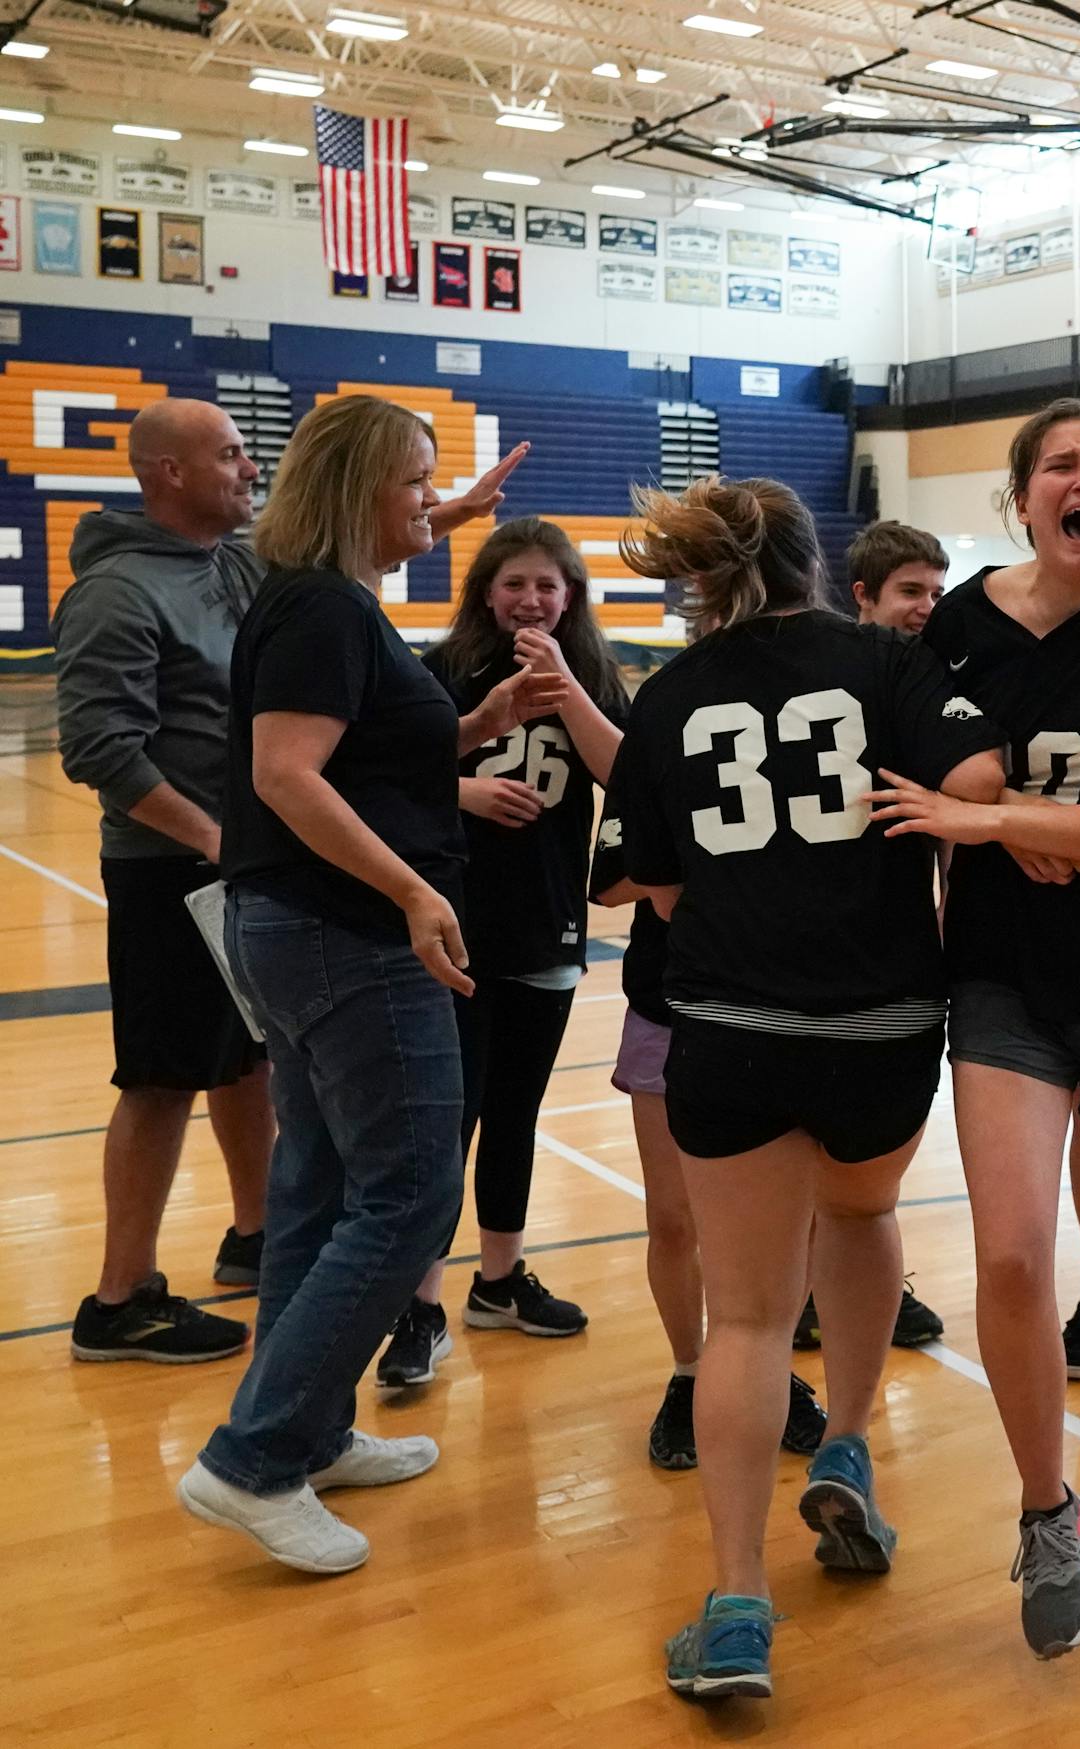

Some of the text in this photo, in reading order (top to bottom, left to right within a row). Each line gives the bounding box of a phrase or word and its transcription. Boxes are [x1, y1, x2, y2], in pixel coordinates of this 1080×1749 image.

[475, 725, 570, 809] 26
[682, 688, 873, 857] 33
[568, 921, 577, 931] M
